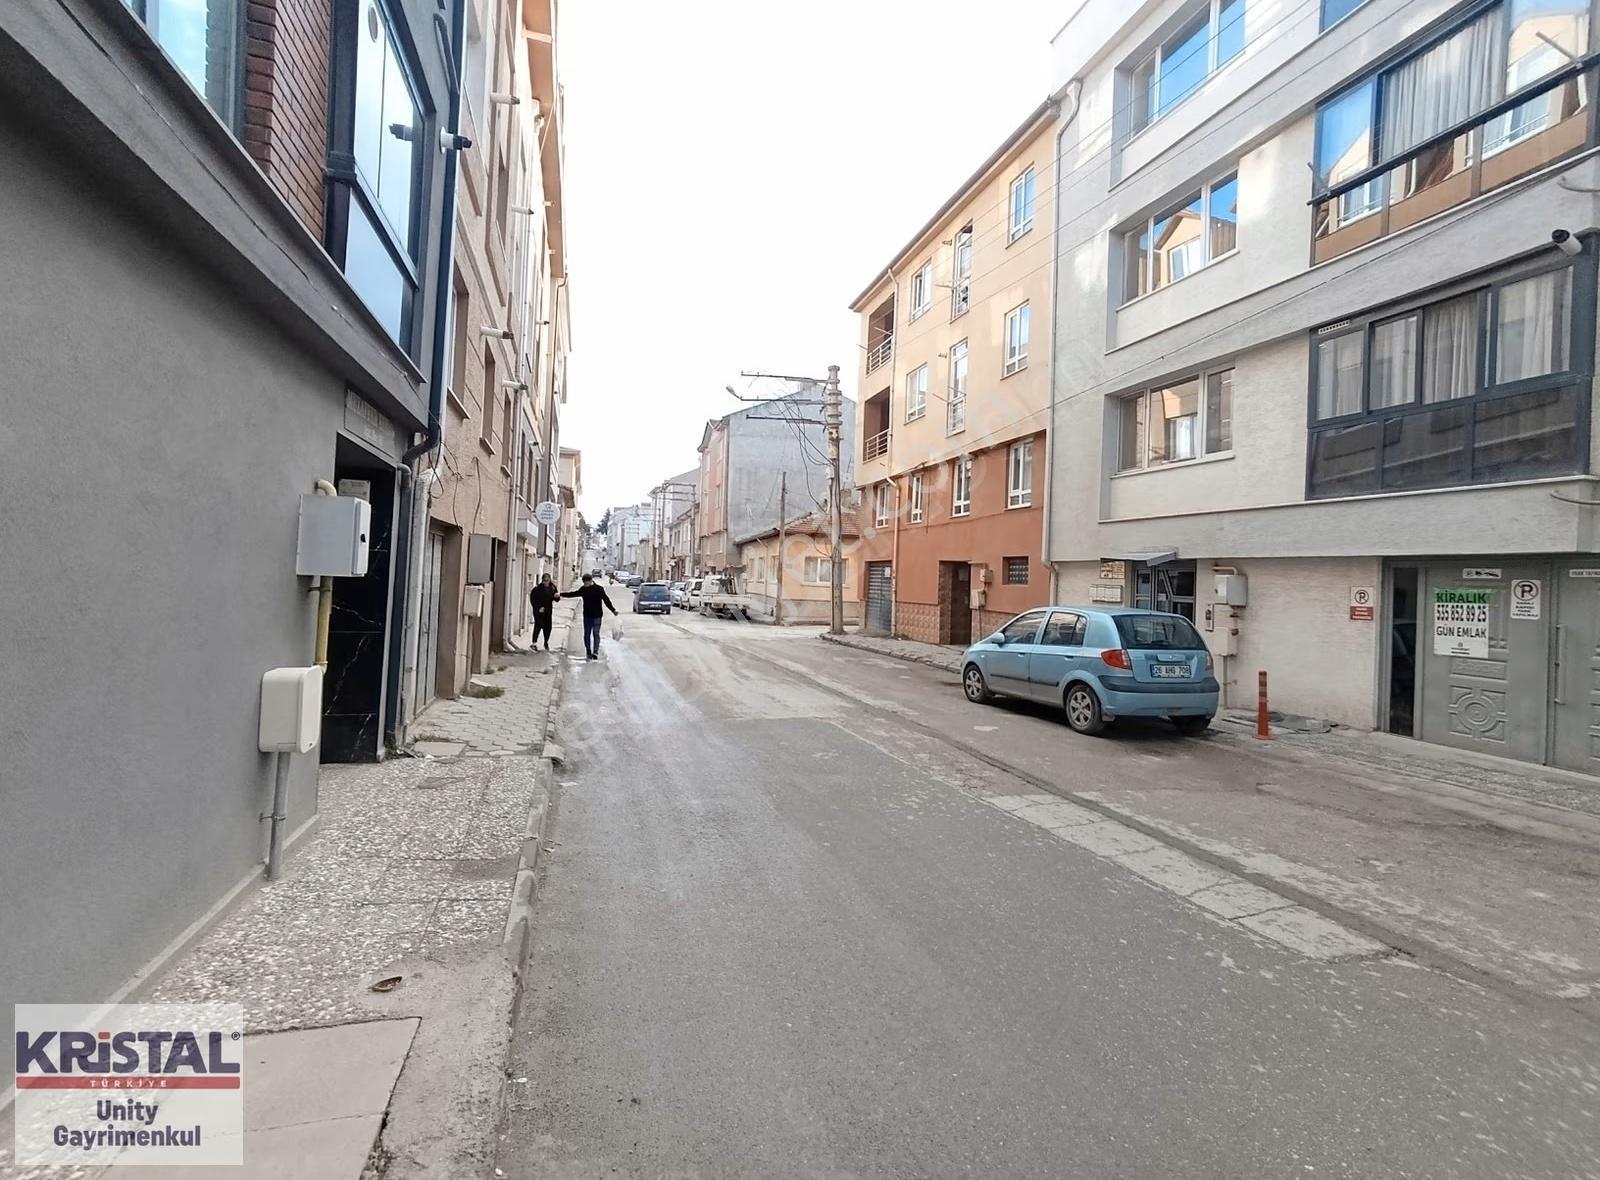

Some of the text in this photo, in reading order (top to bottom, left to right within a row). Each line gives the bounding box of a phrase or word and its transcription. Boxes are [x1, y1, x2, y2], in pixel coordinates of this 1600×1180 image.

[1436, 590, 1487, 604] KİRALIK
[1466, 605, 1475, 622] 89
[1477, 605, 1487, 622] 25
[1457, 626, 1487, 639] EMLAK
